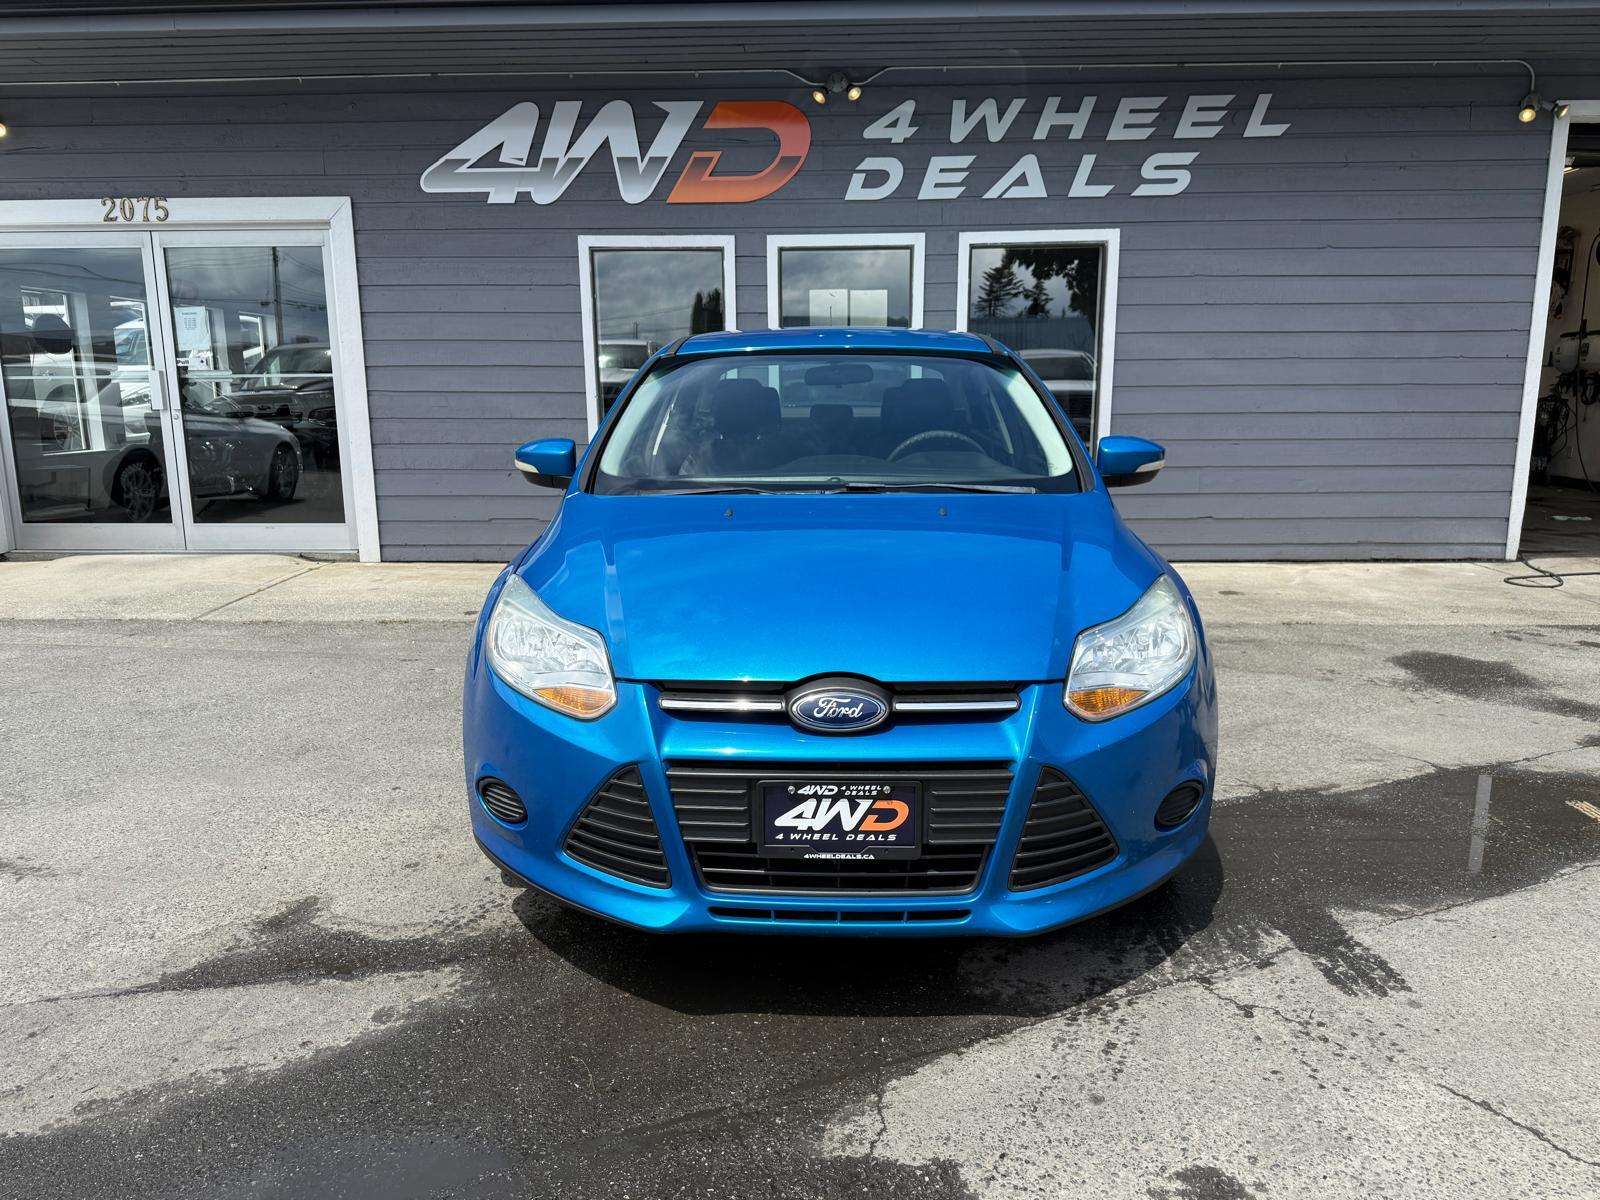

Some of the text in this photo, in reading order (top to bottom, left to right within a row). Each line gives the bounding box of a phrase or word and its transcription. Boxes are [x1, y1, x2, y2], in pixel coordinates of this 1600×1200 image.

[863, 93, 1291, 143] 4 WHEEL
[420, 100, 811, 204] 4WD
[844, 151, 1201, 201] DEALS
[101, 195, 169, 222] 2075
[813, 697, 864, 718] Ford
[797, 785, 838, 796] 4WD
[774, 798, 910, 831] 4WD
[846, 833, 897, 841] DEALS
